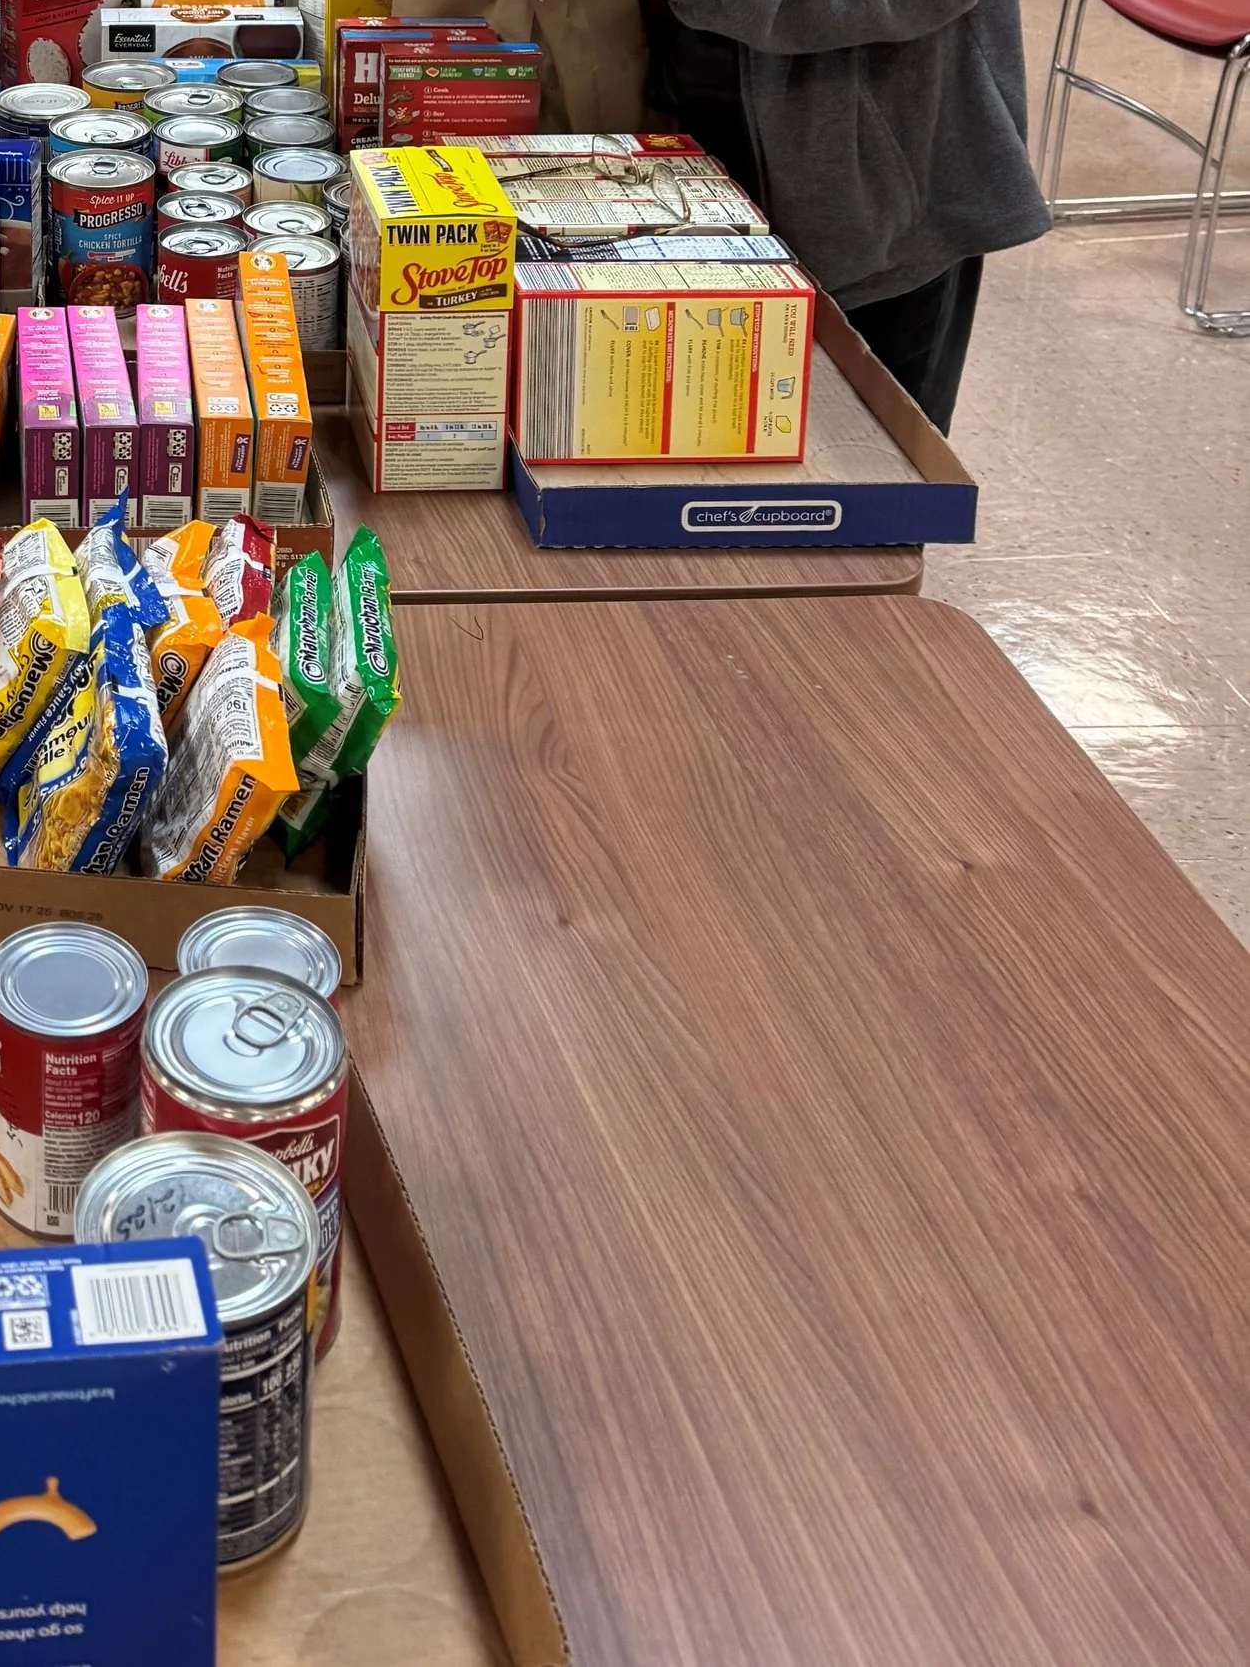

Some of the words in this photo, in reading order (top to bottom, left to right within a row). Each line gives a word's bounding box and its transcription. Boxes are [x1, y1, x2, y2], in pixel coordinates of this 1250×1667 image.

[114, 33, 150, 43] Essential
[354, 93, 379, 105] Delu
[90, 196, 115, 209] Spice
[126, 193, 135, 202] UP
[80, 202, 142, 227] PROGRESSO
[79, 240, 110, 250] CHICKEN
[113, 236, 142, 249] TORTILLA
[386, 225, 429, 246] TWIN
[435, 224, 478, 245] PACK
[436, 291, 478, 307] TURKEY
[697, 511, 737, 522] chef's
[754, 510, 825, 523] cupboard
[301, 567, 318, 606] Ramen
[358, 596, 383, 654] Maruchan
[299, 606, 318, 661] Maruchan
[47, 682, 73, 716] Sauce
[27, 716, 50, 742] Flavor
[106, 766, 150, 842] Ramen
[211, 773, 257, 847] Ramen
[235, 815, 255, 847] Flavor
[19, 905, 32, 914] 17
[45, 1053, 97, 1065] Nutrition
[46, 1064, 78, 1076] Facts
[45, 1111, 77, 1121] Calories
[77, 1109, 101, 1125] 120
[48, 1602, 87, 1618] help
[37, 1622, 61, 1638] go
[63, 1623, 84, 1636] so
